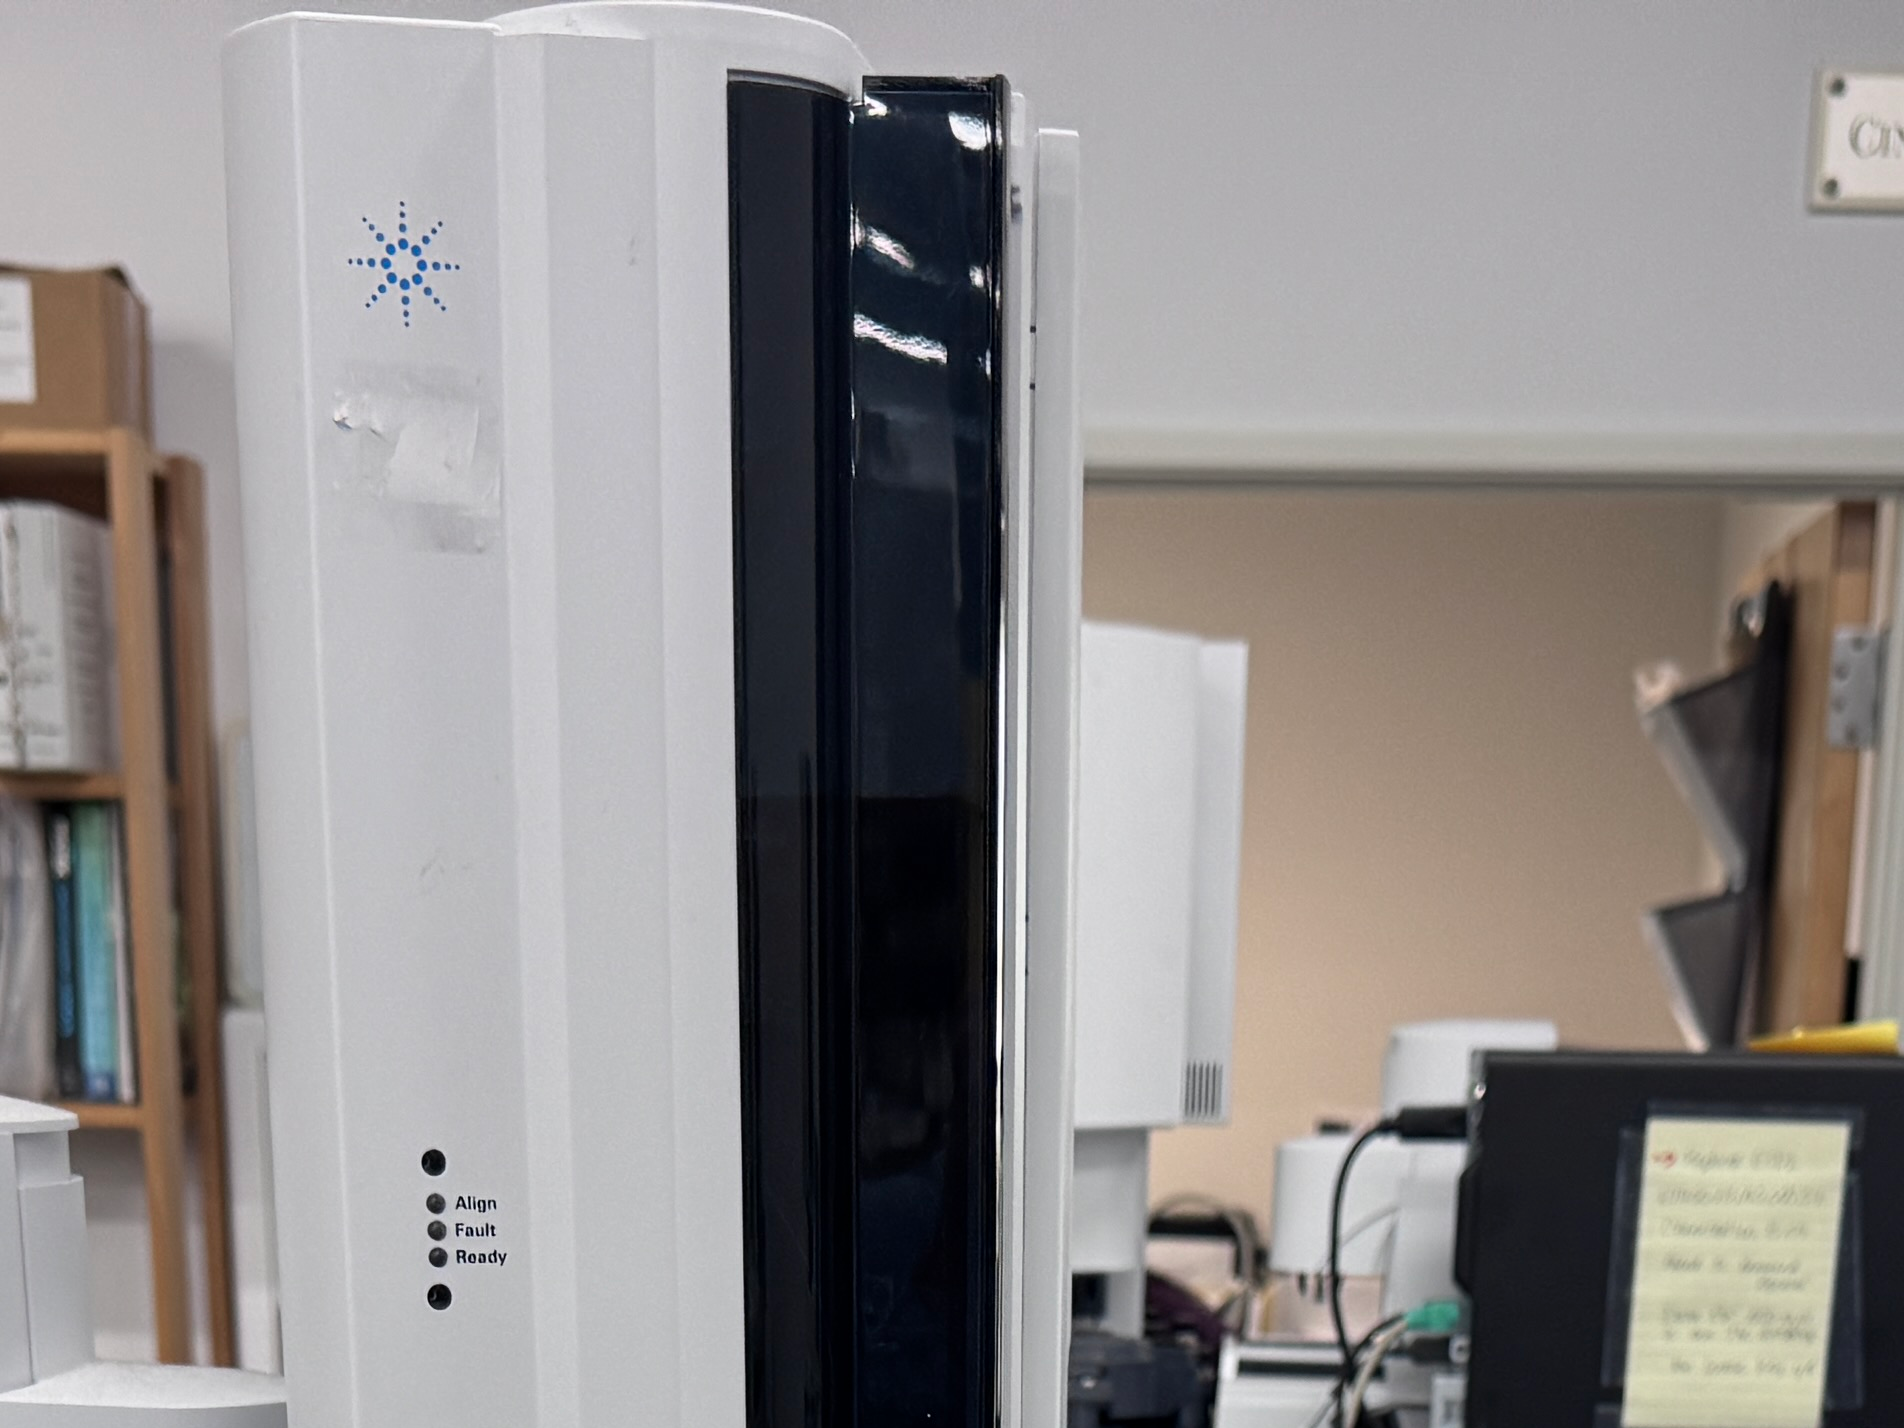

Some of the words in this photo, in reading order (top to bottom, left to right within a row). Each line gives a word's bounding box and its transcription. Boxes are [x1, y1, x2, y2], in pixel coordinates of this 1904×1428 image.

[455, 1195, 497, 1214] Align
[455, 1222, 496, 1238] Fault
[455, 1249, 508, 1267] Ready
